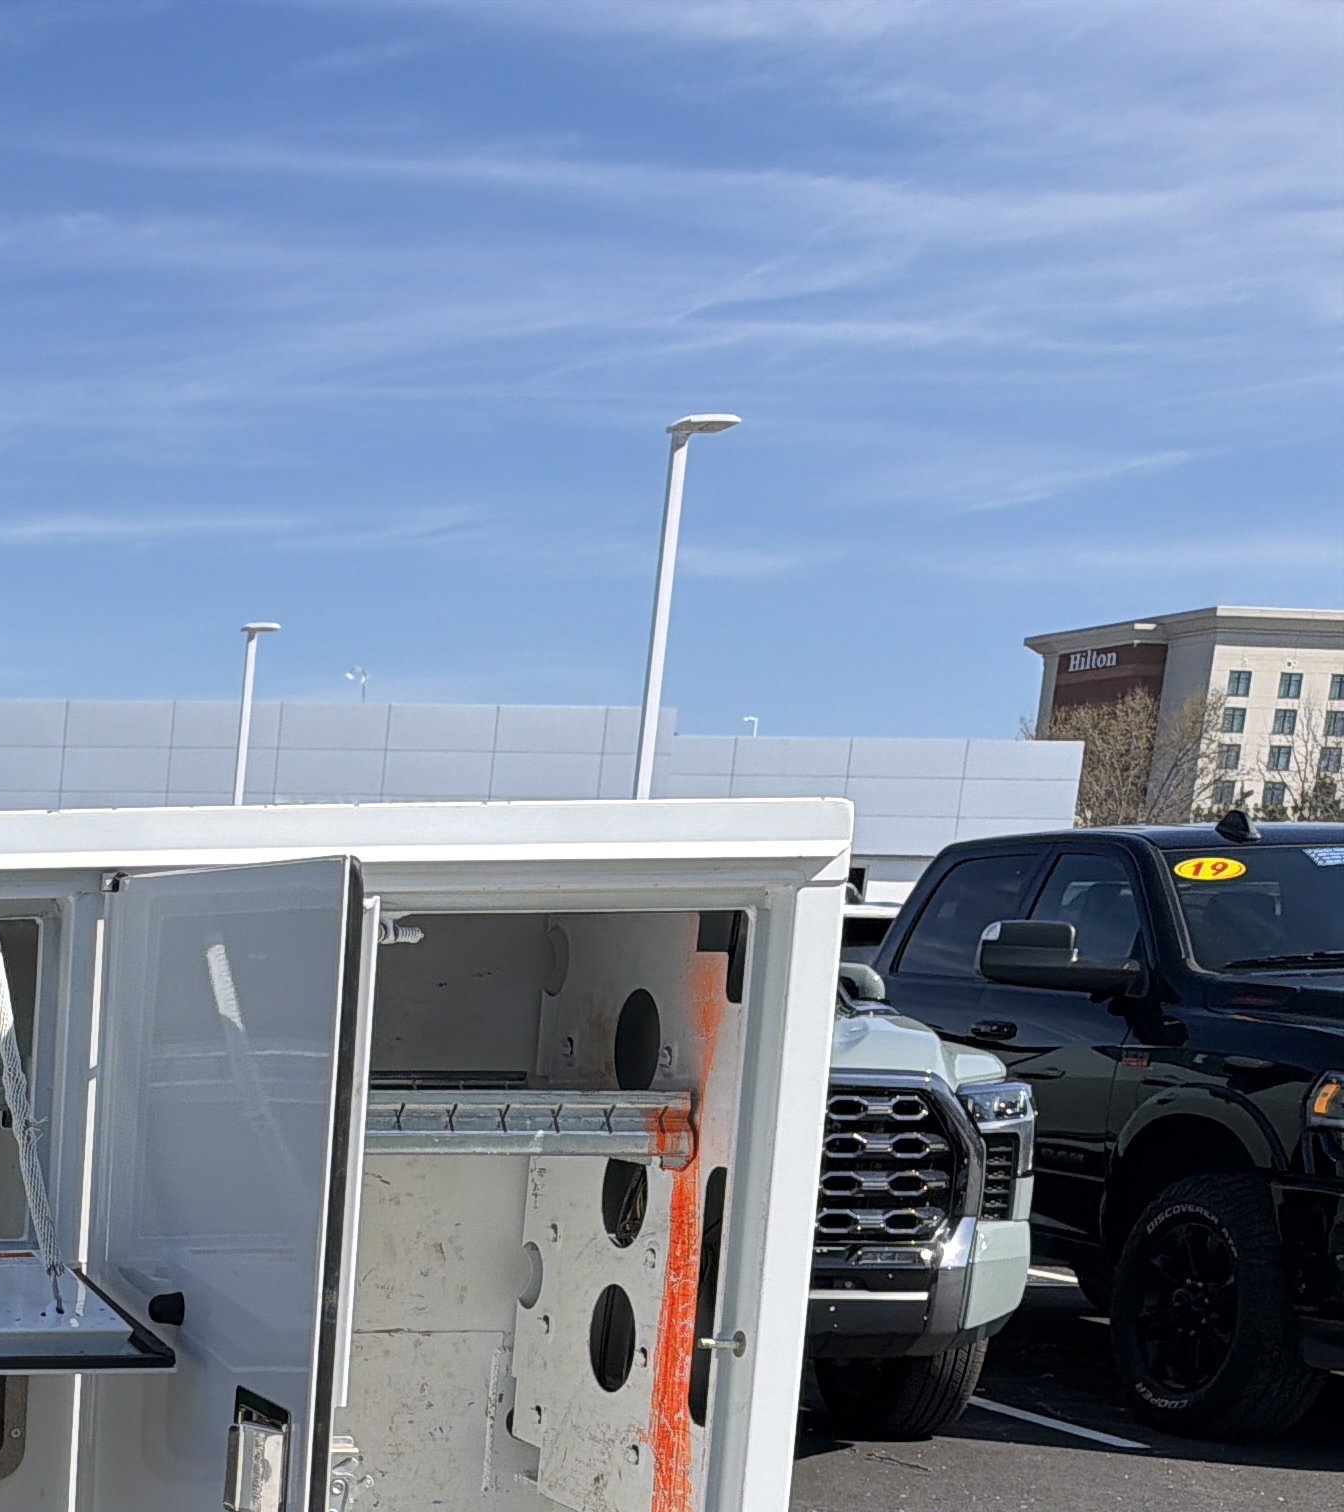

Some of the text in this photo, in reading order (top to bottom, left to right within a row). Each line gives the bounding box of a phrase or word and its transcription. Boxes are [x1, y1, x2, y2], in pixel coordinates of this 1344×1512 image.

[1068, 649, 1117, 673] Hilton
[1191, 861, 1229, 878] 19
[1146, 1203, 1219, 1235] DISCOVERER
